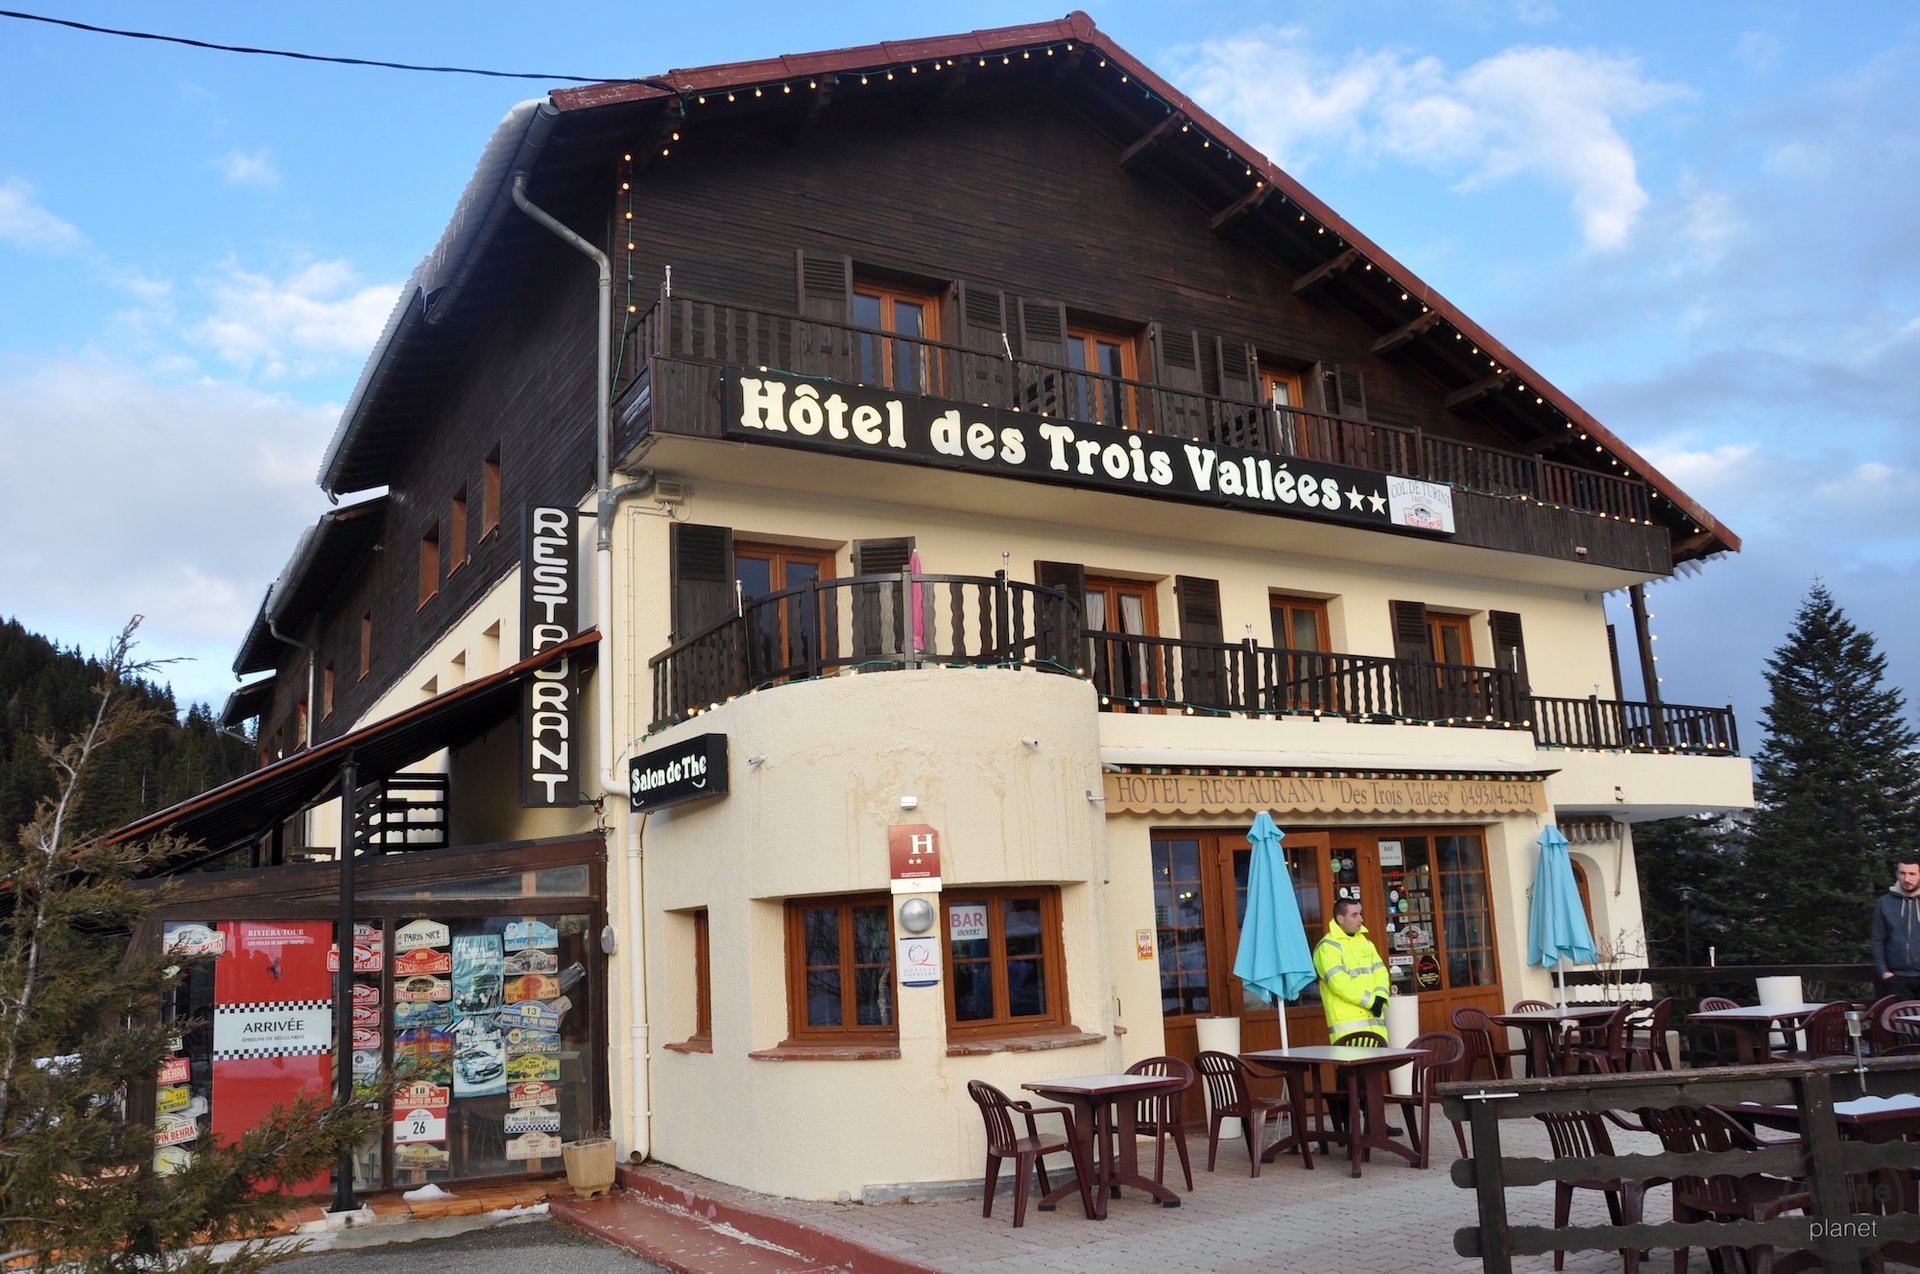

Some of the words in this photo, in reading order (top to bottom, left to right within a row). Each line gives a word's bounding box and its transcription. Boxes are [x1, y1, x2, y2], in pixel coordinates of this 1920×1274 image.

[739, 376, 907, 449] Hôtel
[929, 409, 1027, 465] des
[1039, 422, 1174, 486] Trois
[1183, 443, 1342, 511] Vallées
[532, 507, 569, 804] RESTAURANT
[631, 767, 666, 794] Salon
[666, 760, 682, 784] de
[1369, 781, 1403, 806] Trois
[909, 833, 935, 855] H
[951, 912, 984, 928] BAR
[247, 929, 280, 937] RIVIERA
[281, 928, 305, 937] TOUR
[425, 929, 441, 939] NICE
[957, 928, 981, 936] OUVERT
[527, 1007, 537, 1016] 13
[242, 1017, 305, 1034] ARRIVÉE
[162, 1065, 187, 1081] BEHRA
[415, 1086, 426, 1095] 18
[170, 1126, 195, 1141] BEHRA
[413, 1120, 426, 1135] 26
